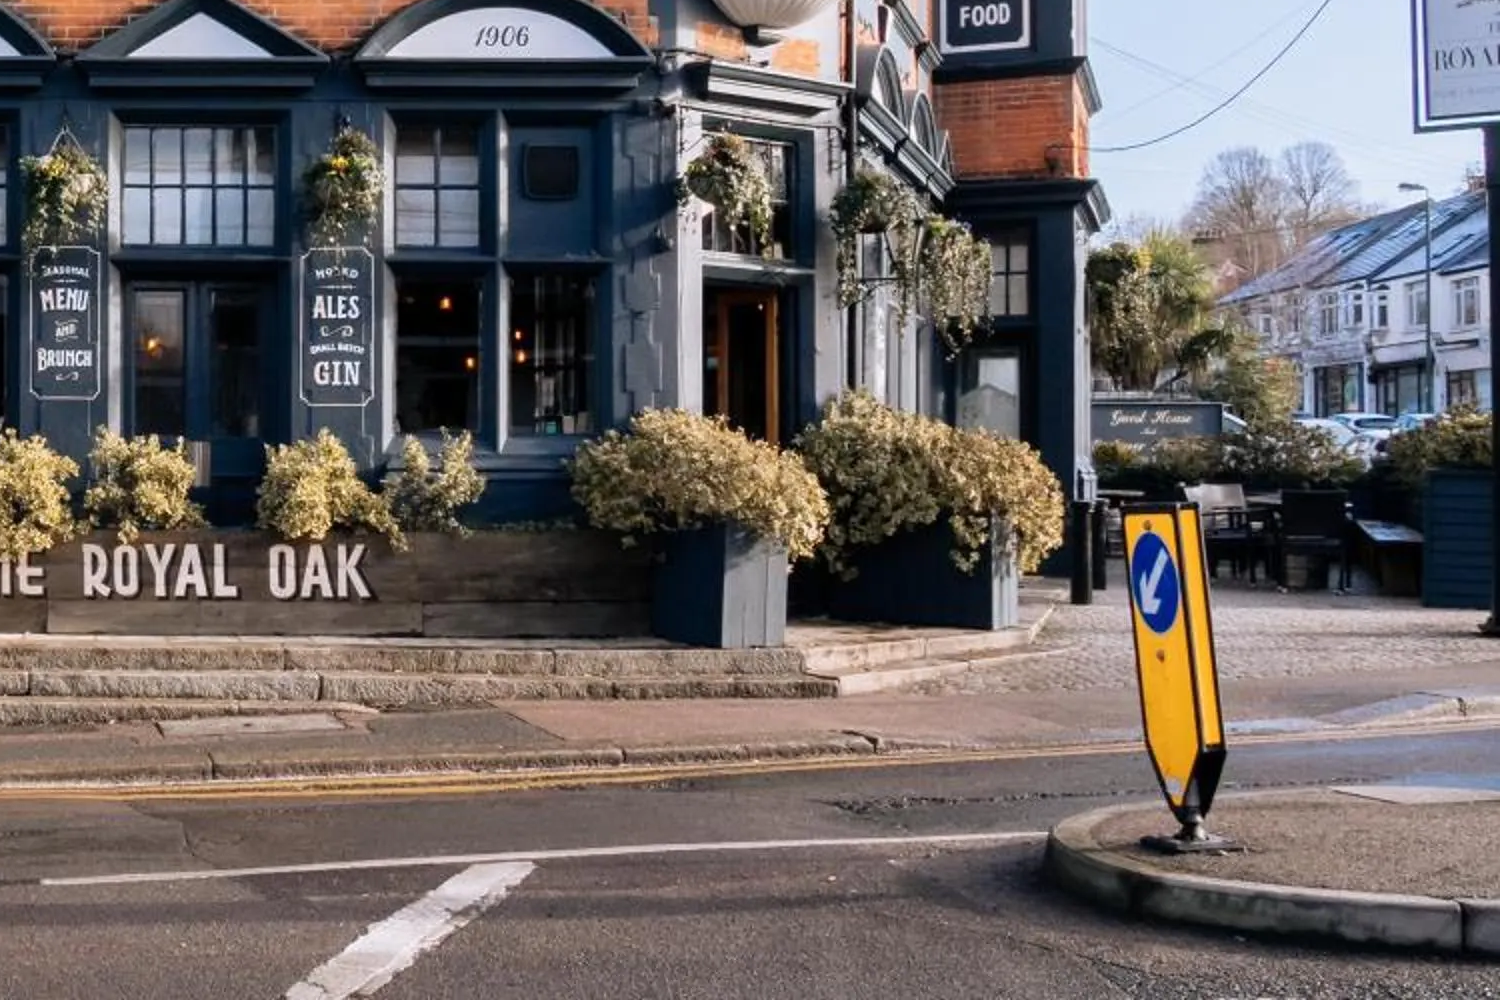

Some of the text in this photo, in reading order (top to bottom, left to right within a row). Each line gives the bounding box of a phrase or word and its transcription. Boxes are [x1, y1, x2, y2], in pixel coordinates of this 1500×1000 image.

[959, 3, 1011, 28] FOOD
[475, 25, 529, 47] 1906
[40, 288, 89, 312] MENU
[313, 295, 360, 320] ALES
[55, 323, 77, 337] AND
[37, 347, 93, 372] BRUNCH
[310, 344, 337, 355] SMALL
[314, 361, 361, 386] GIN
[82, 542, 239, 598] ROYAL
[268, 542, 372, 598] OAK
